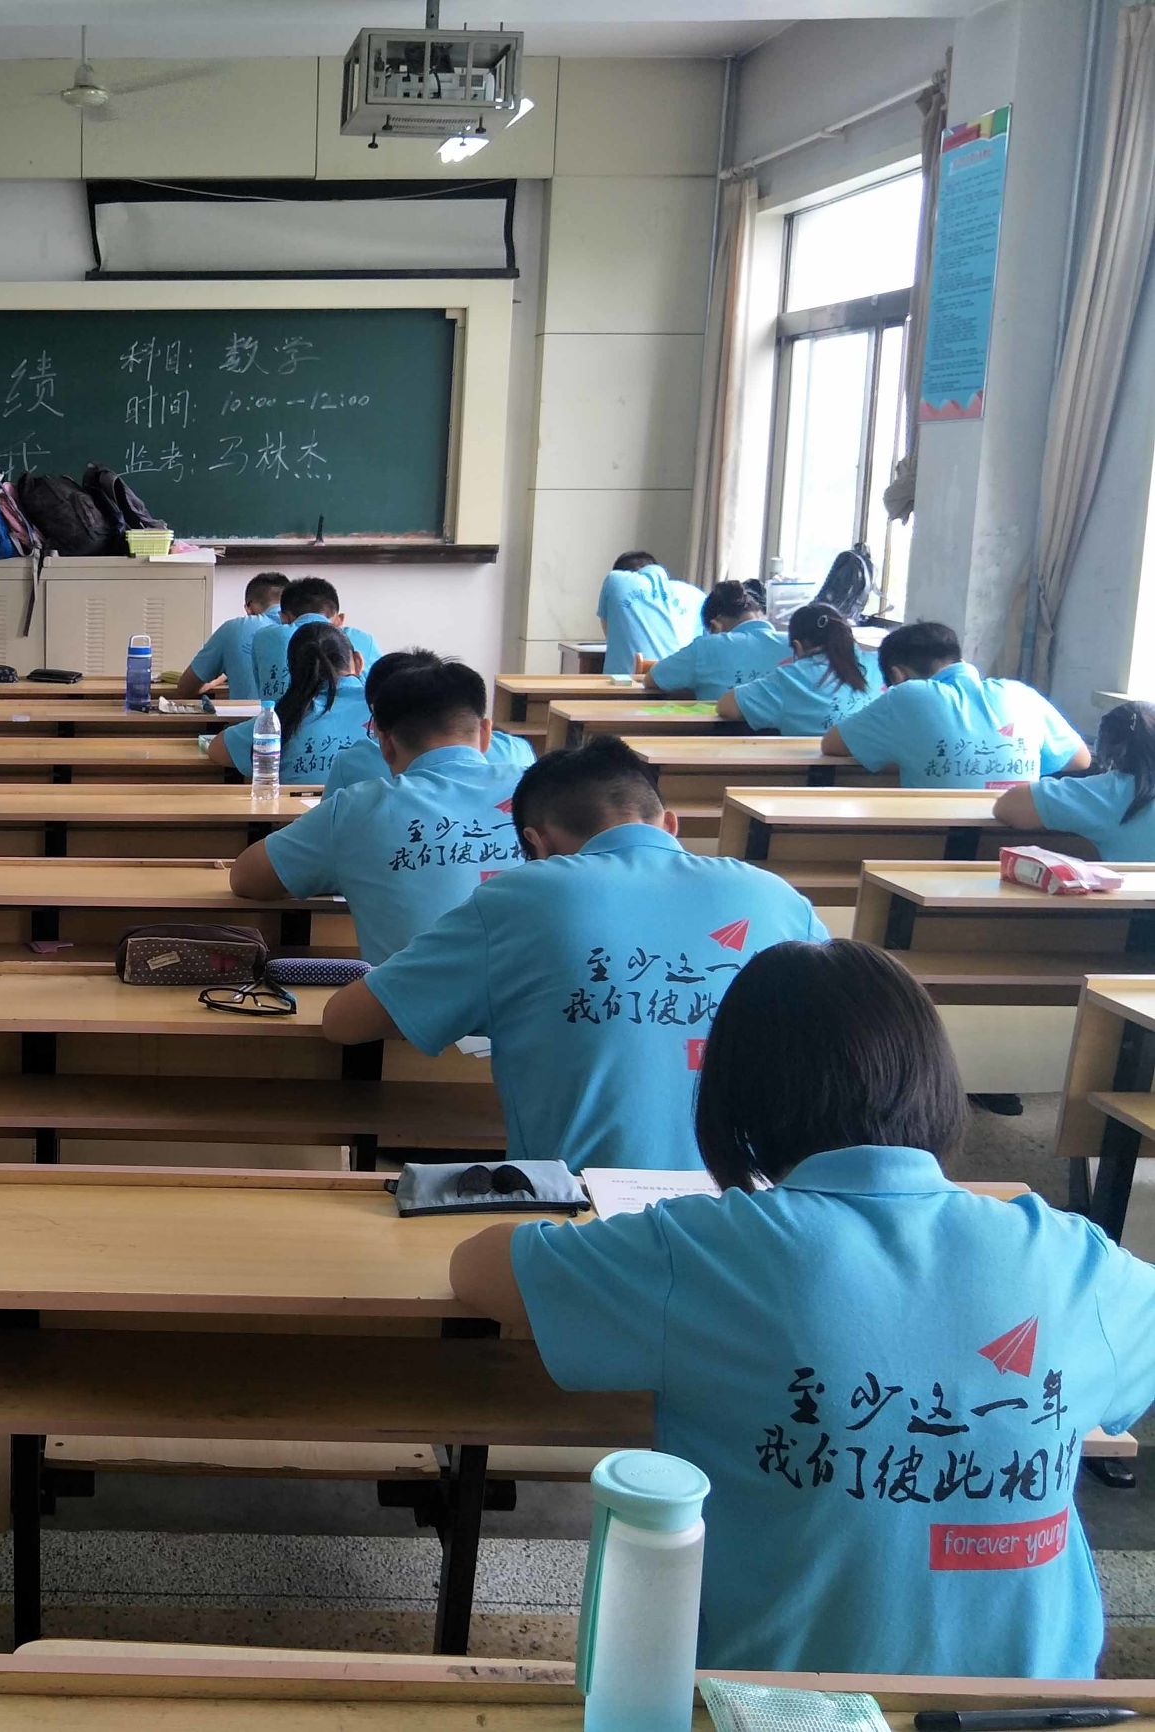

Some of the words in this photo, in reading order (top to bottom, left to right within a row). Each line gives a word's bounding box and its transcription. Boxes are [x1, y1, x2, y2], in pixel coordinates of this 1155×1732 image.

[218, 332, 321, 376] 数学
[787, 1366, 1069, 1437] 至少这一年
[755, 1424, 1078, 1504] 我们彼此相伴
[942, 1529, 1020, 1556] forever
[1024, 1517, 1066, 1564] young
